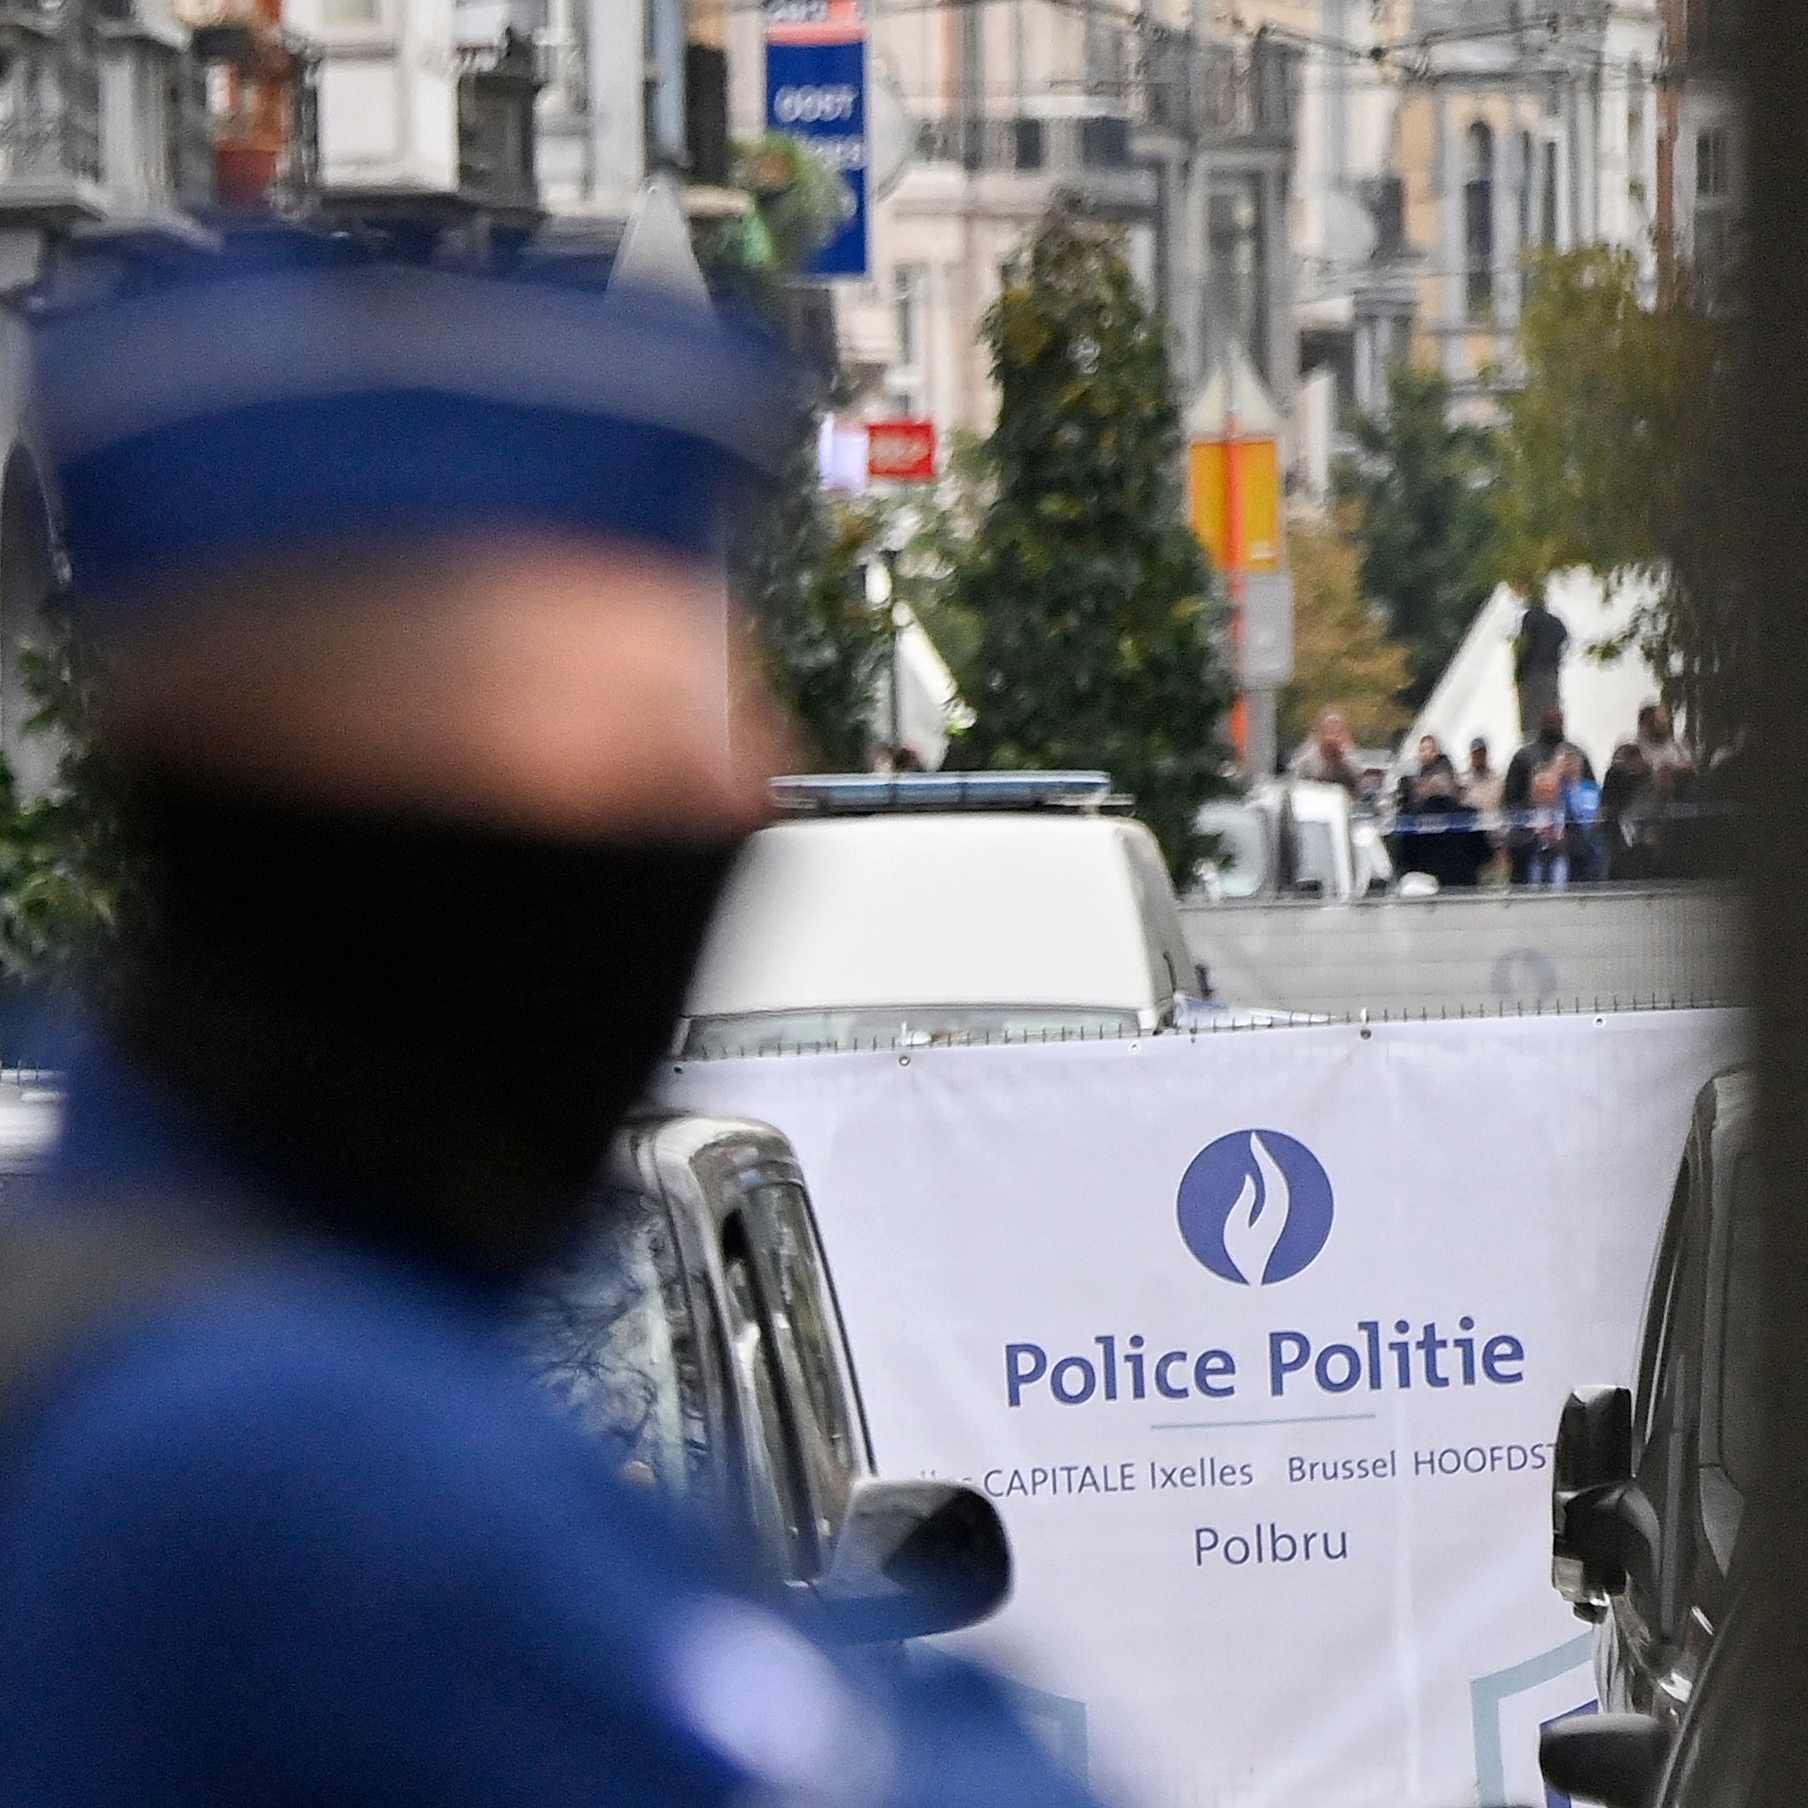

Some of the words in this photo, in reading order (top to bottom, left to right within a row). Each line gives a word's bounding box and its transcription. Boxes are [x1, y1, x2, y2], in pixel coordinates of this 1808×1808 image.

[1005, 1335, 1236, 1406] Police
[1269, 1316, 1525, 1397] Politie
[984, 1463, 1136, 1497] CAPITALE
[1150, 1457, 1254, 1490] Ixelles
[1288, 1450, 1396, 1483] Brussel
[1195, 1523, 1349, 1566] Polbru
